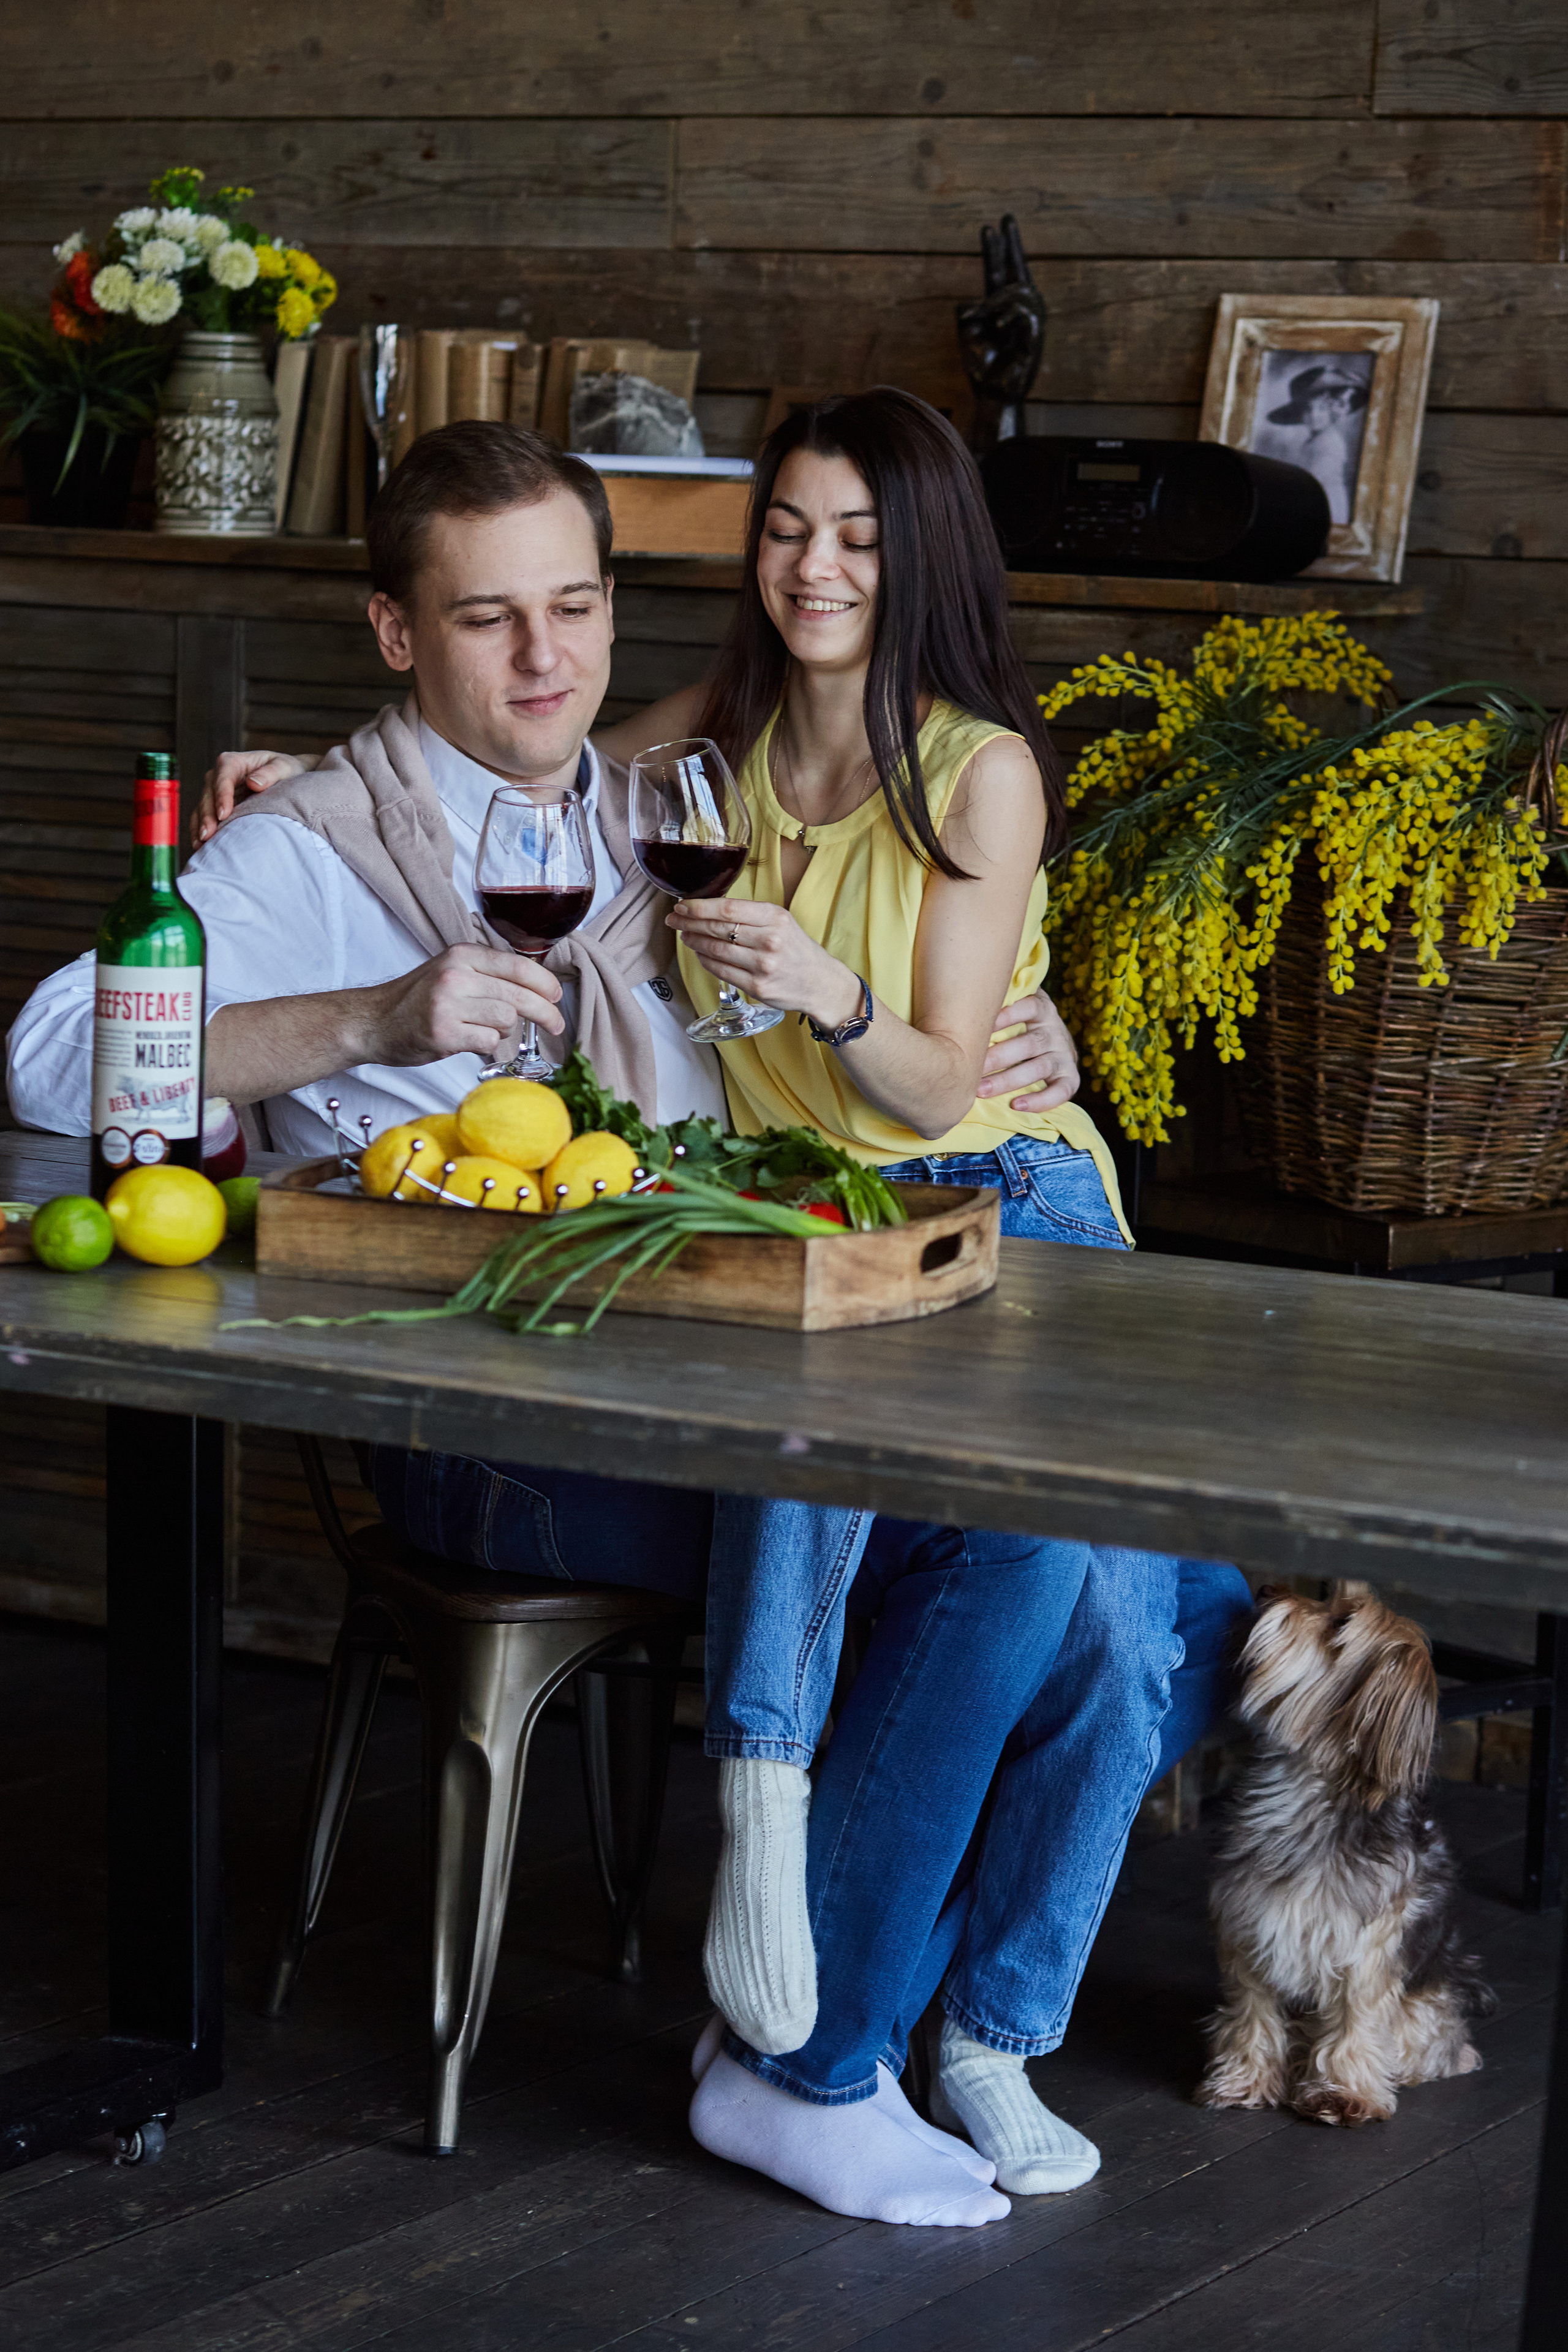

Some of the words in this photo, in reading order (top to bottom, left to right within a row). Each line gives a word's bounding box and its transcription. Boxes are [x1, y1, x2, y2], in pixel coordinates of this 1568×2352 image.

[135, 1044, 190, 1068] MALBEC
[140, 1091, 149, 1106] &
[152, 1077, 195, 1104] LIBERTY
